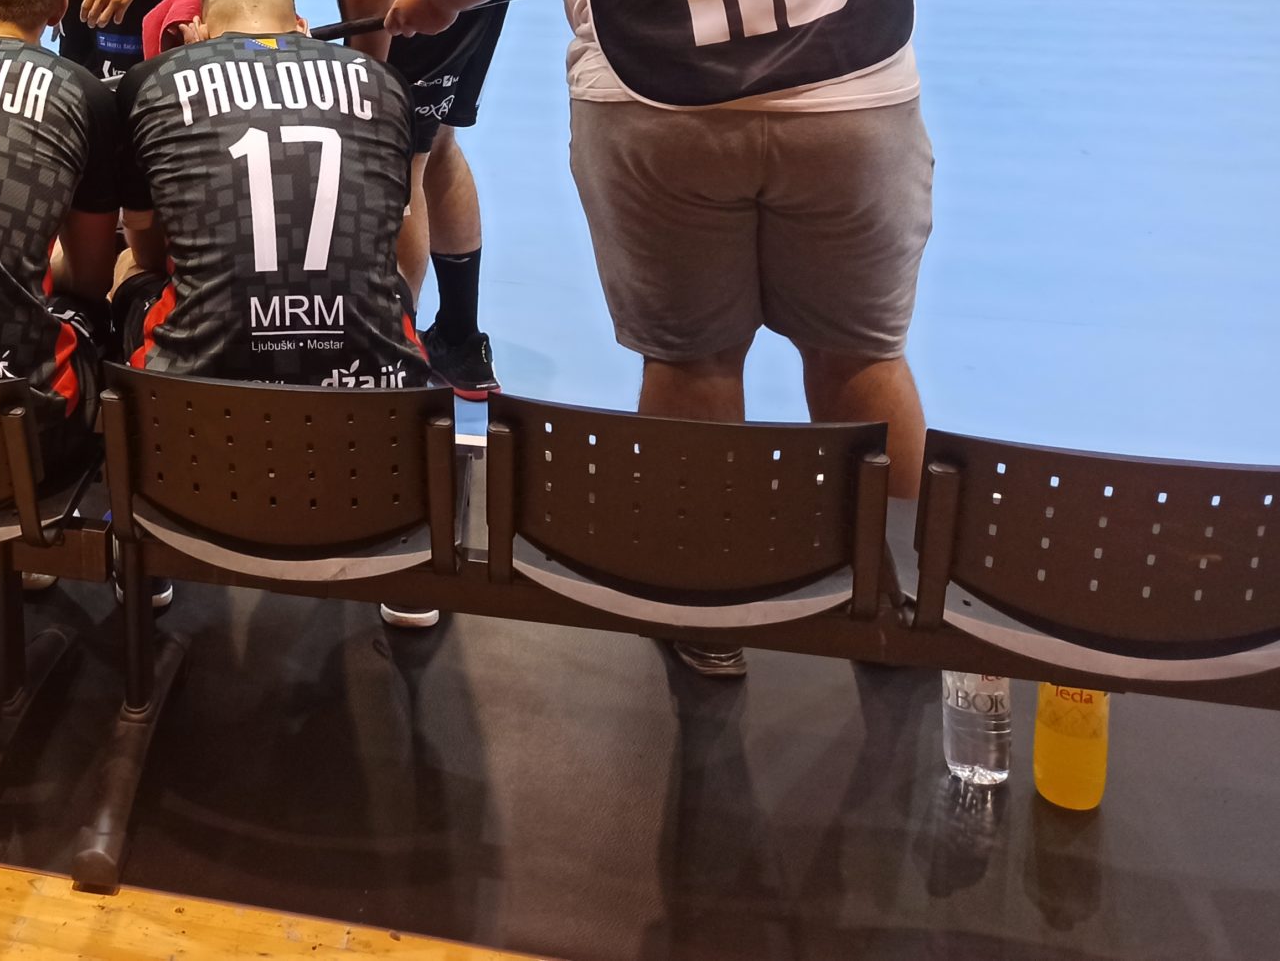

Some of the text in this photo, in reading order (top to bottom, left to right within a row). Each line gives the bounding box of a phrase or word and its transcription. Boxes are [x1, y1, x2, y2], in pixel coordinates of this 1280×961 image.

[173, 57, 373, 127] PAVLOVIĆ
[227, 125, 342, 273] 17
[249, 294, 345, 328] MRM
[251, 339, 345, 355] Ljubuški Mostar
